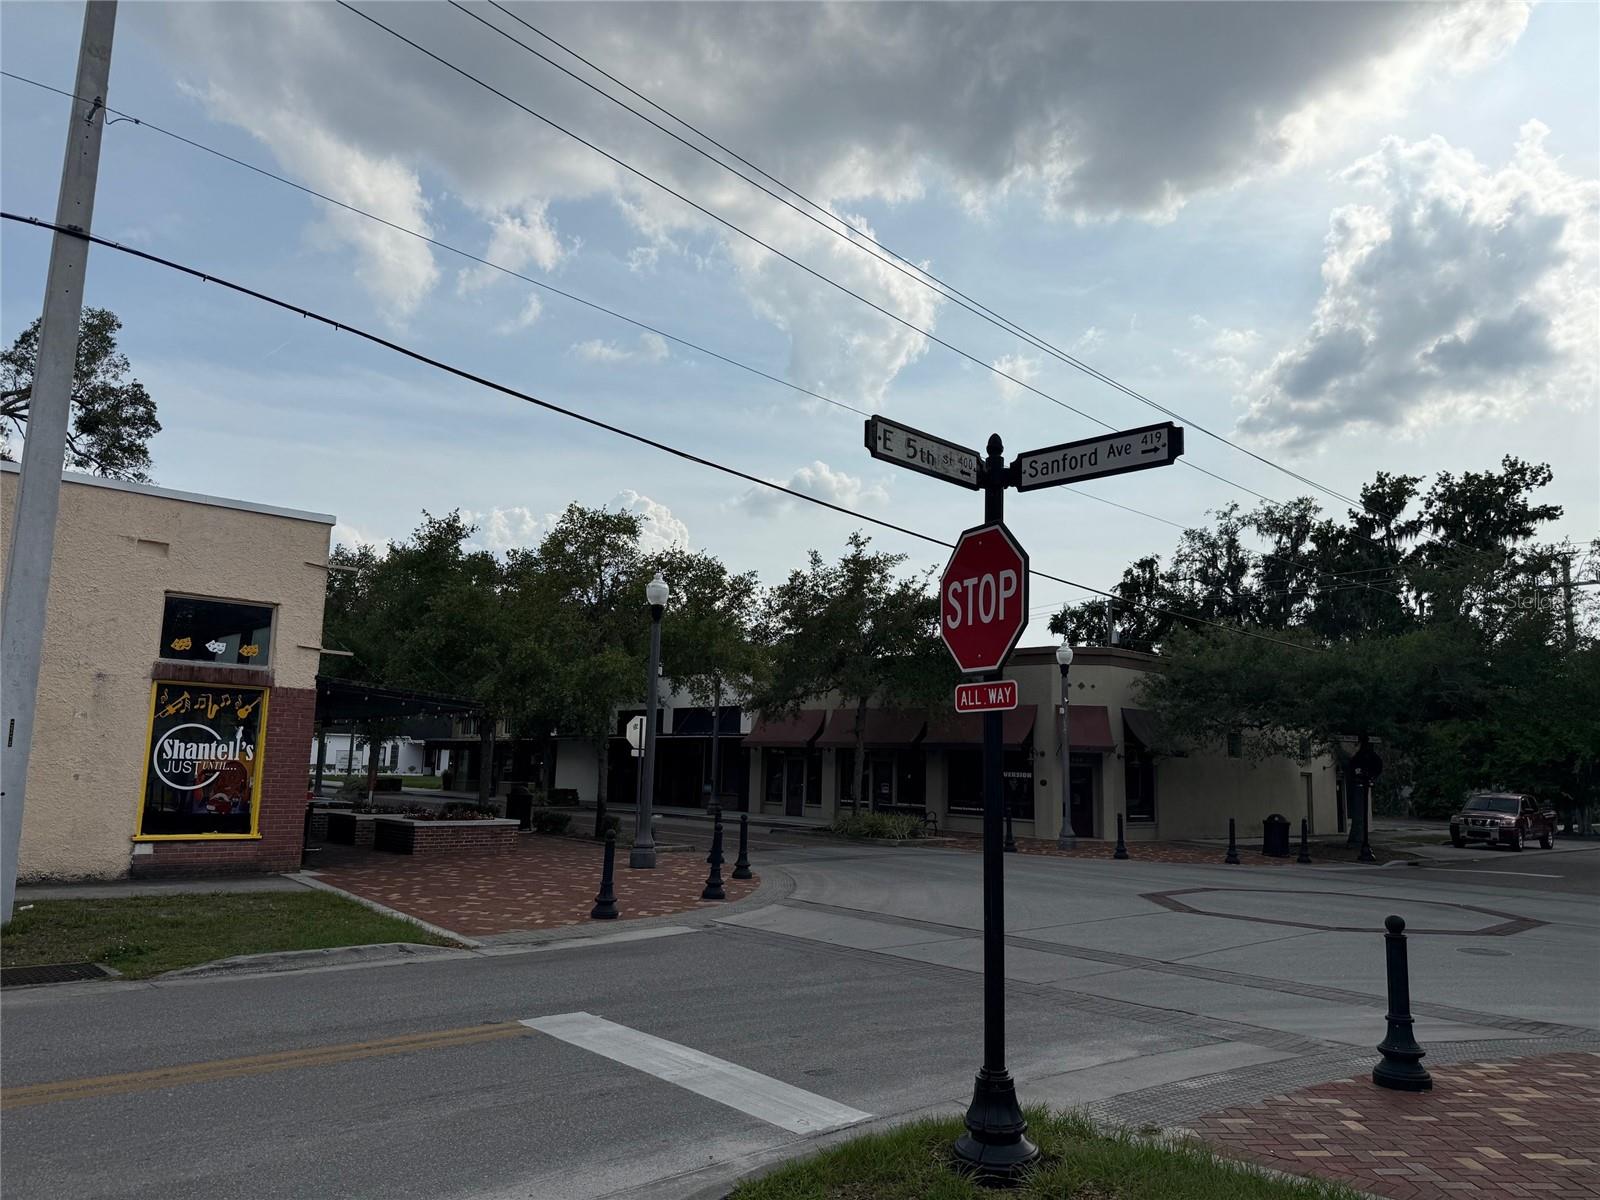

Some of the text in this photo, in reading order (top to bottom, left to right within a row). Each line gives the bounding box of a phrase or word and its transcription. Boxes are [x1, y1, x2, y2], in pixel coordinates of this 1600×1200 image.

[883, 428, 894, 452] E
[906, 438, 934, 466] 5th
[1028, 432, 1162, 479] Sanford Ave 419
[946, 568, 1017, 630] STOP
[960, 686, 1012, 707] ALL WAY
[162, 726, 254, 761] Shantell's
[163, 760, 202, 776] JUST
